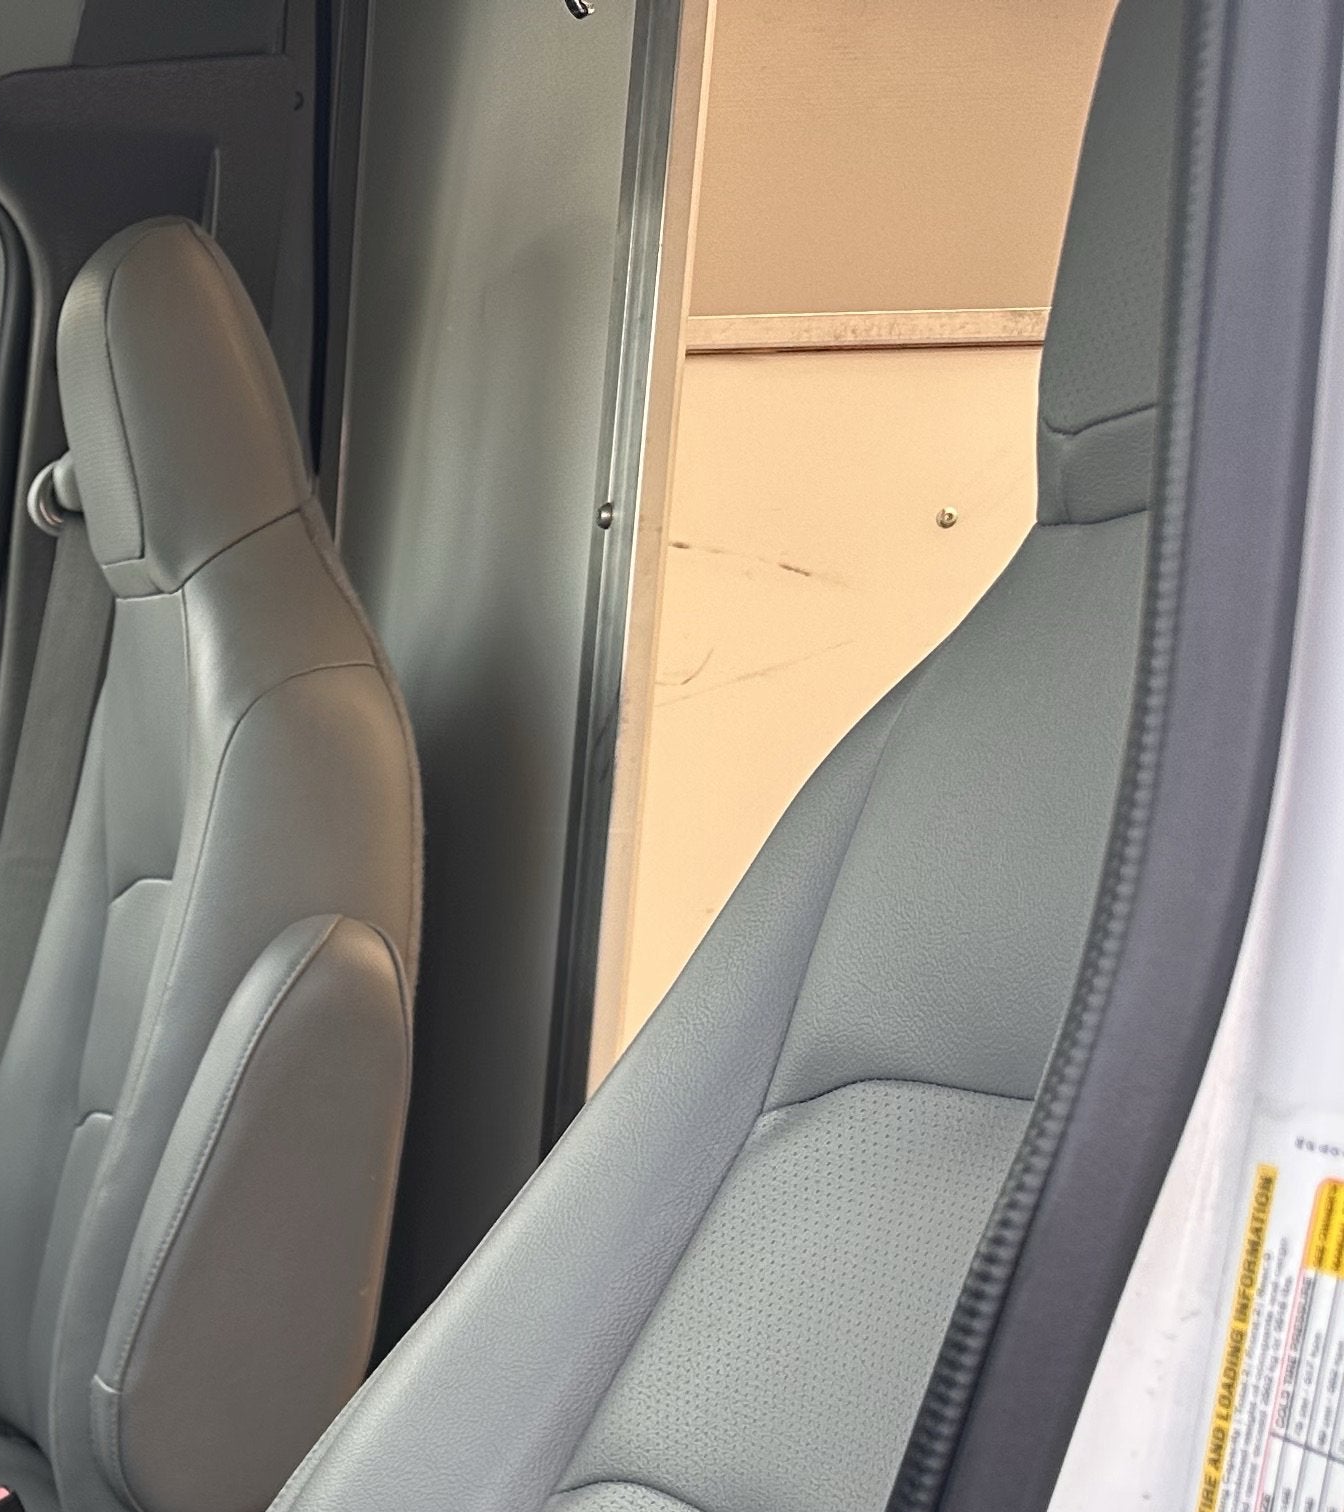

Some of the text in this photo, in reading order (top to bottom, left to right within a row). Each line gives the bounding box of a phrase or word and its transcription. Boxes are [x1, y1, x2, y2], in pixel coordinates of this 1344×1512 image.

[1235, 1176, 1273, 1323] INFORMATION
[1217, 1329, 1245, 1422] LOADING
[1209, 1426, 1226, 1471] AND
